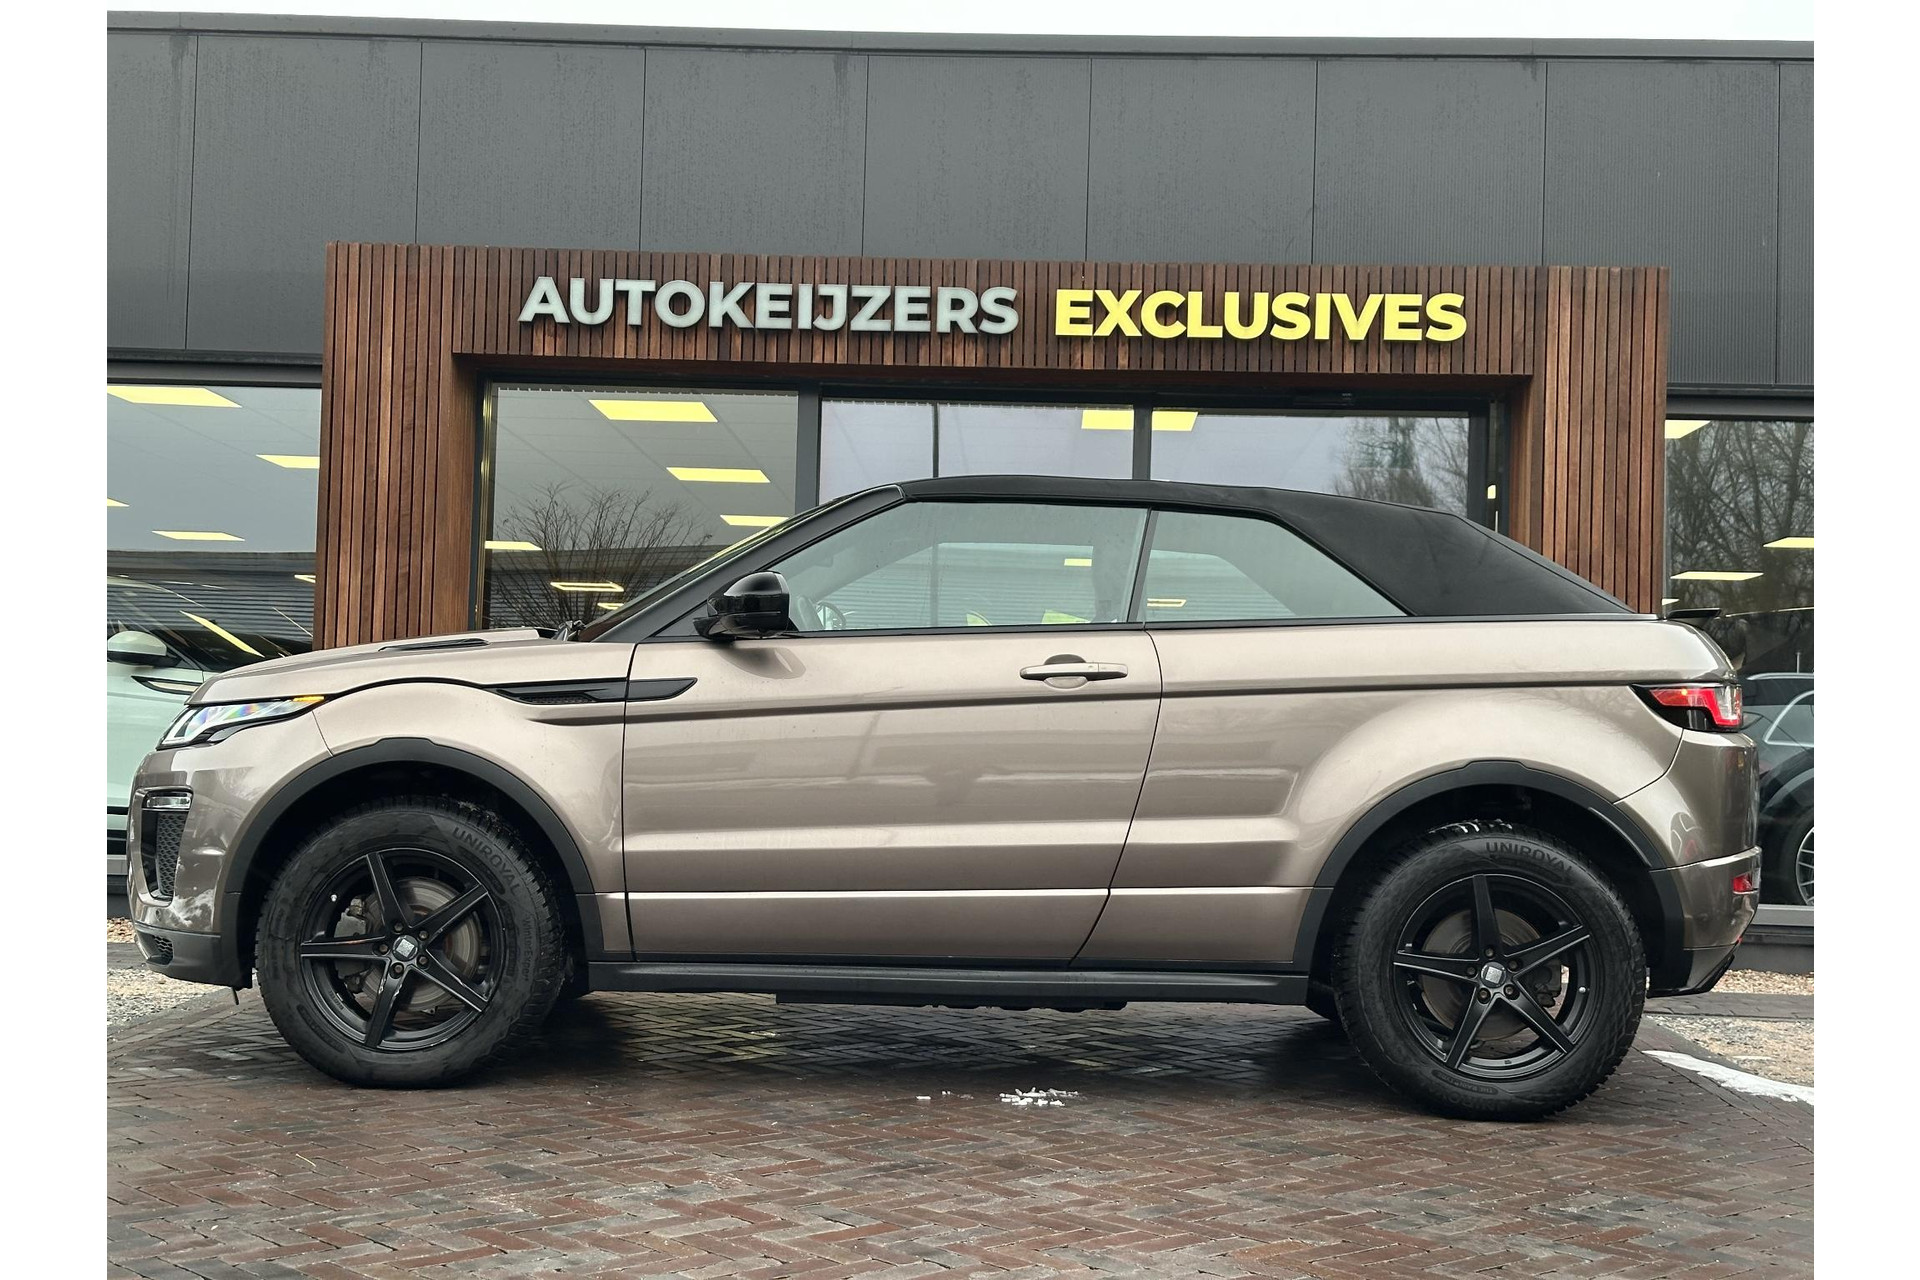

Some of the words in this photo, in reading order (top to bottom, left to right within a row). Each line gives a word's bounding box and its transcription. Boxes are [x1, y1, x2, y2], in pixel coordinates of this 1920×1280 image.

[517, 276, 1019, 335] AUTOKEIJZERS
[1055, 289, 1467, 342] EXCLUSIVES
[452, 826, 522, 896] UNIROYAL
